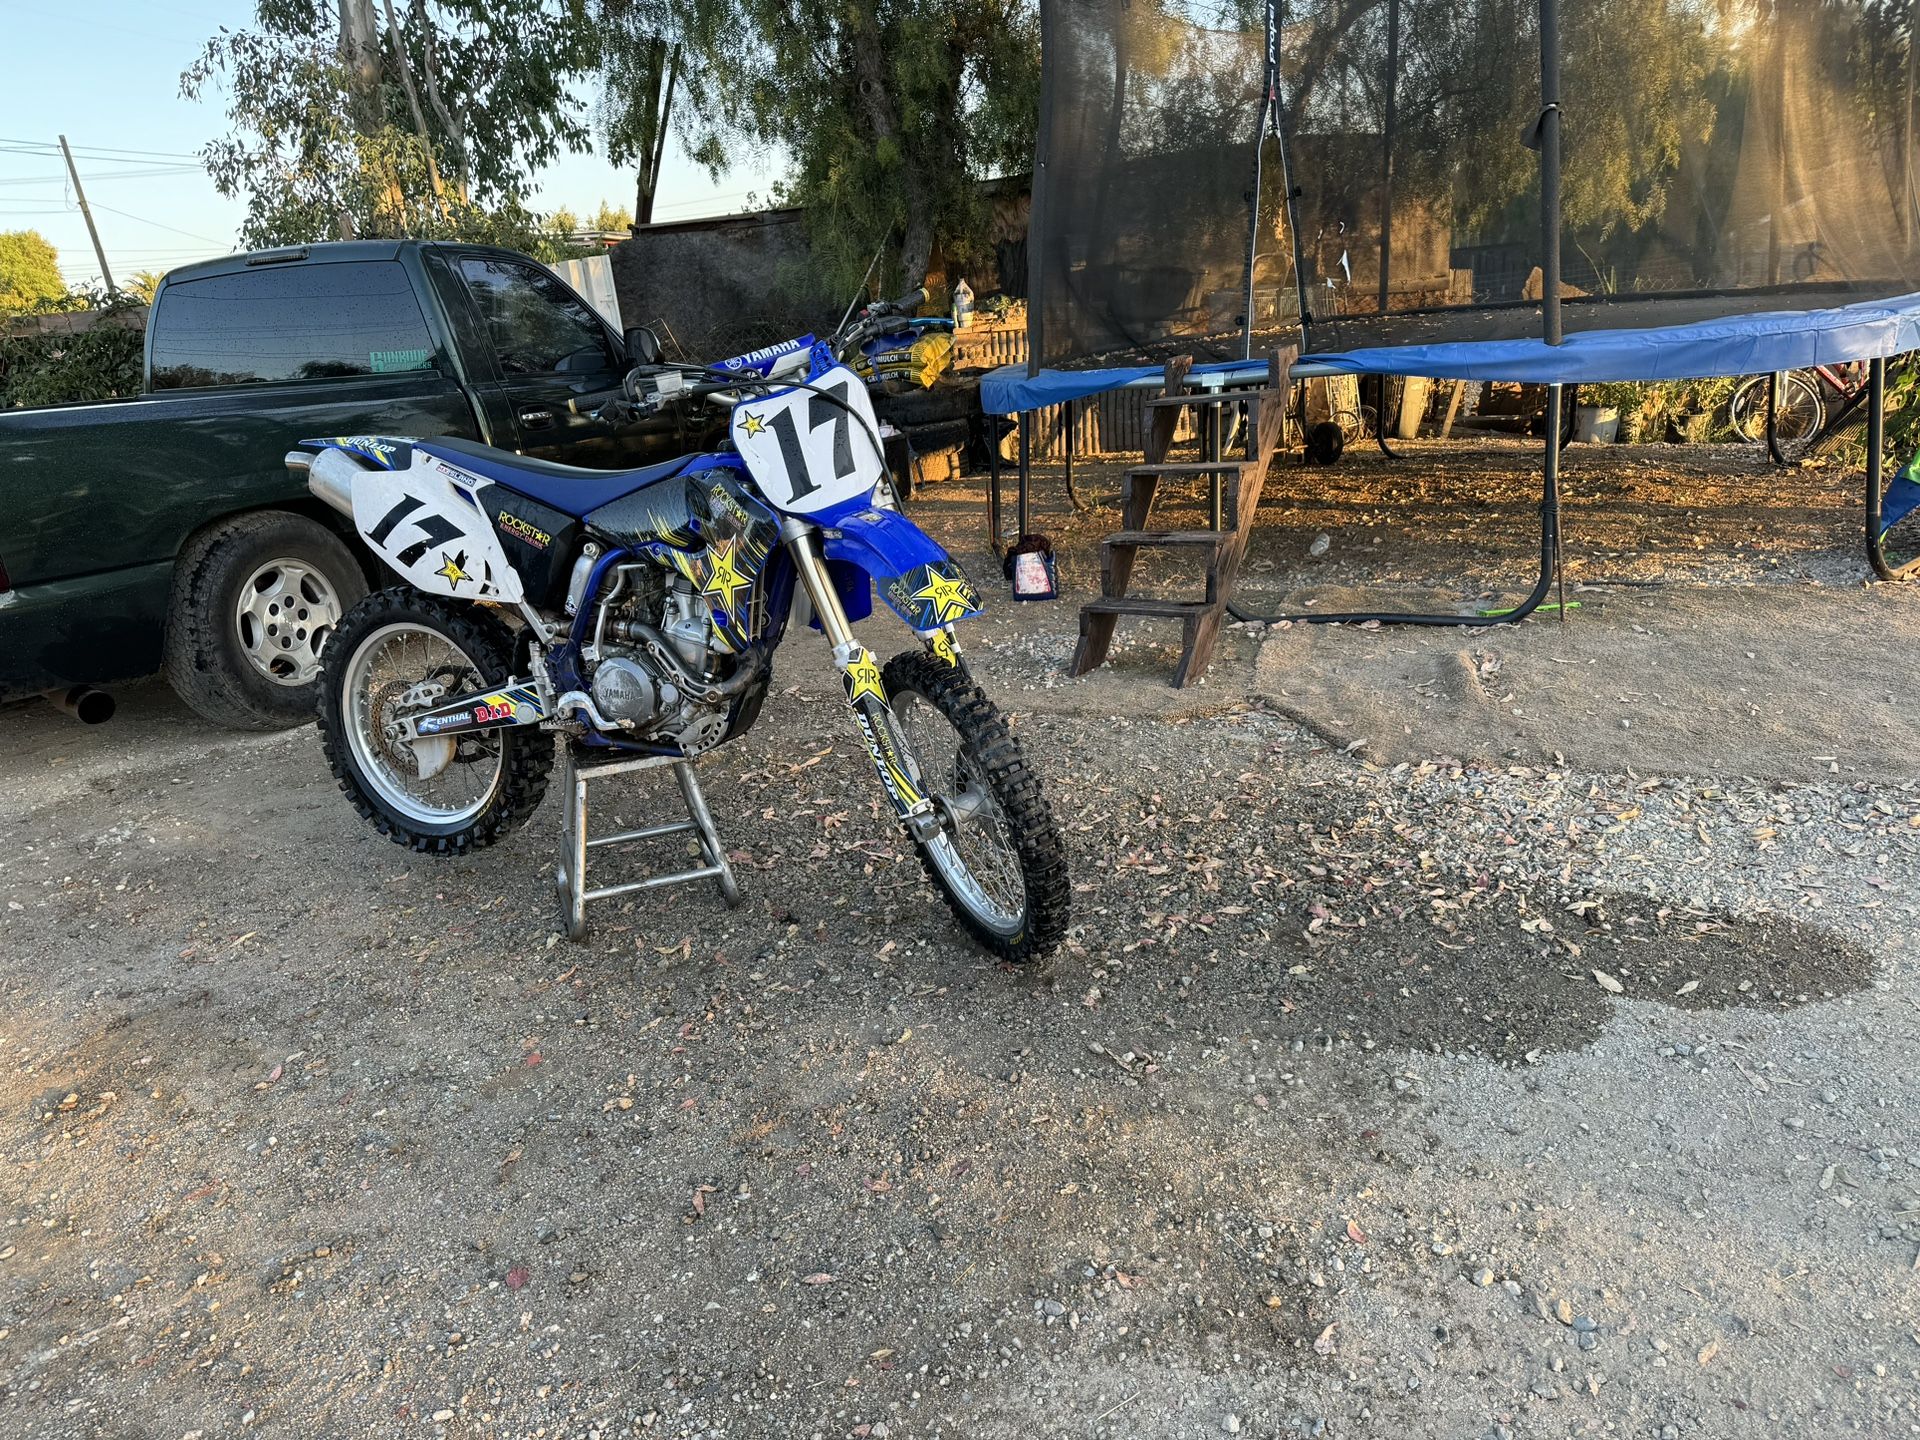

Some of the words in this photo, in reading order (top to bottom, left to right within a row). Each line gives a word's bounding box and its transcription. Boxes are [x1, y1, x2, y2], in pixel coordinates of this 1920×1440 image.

[742, 339, 801, 364] YAMAHA
[346, 437, 397, 453] DUNLOP
[764, 380, 856, 505] 17
[364, 493, 466, 568] 17
[857, 713, 899, 800] DUNLOP
